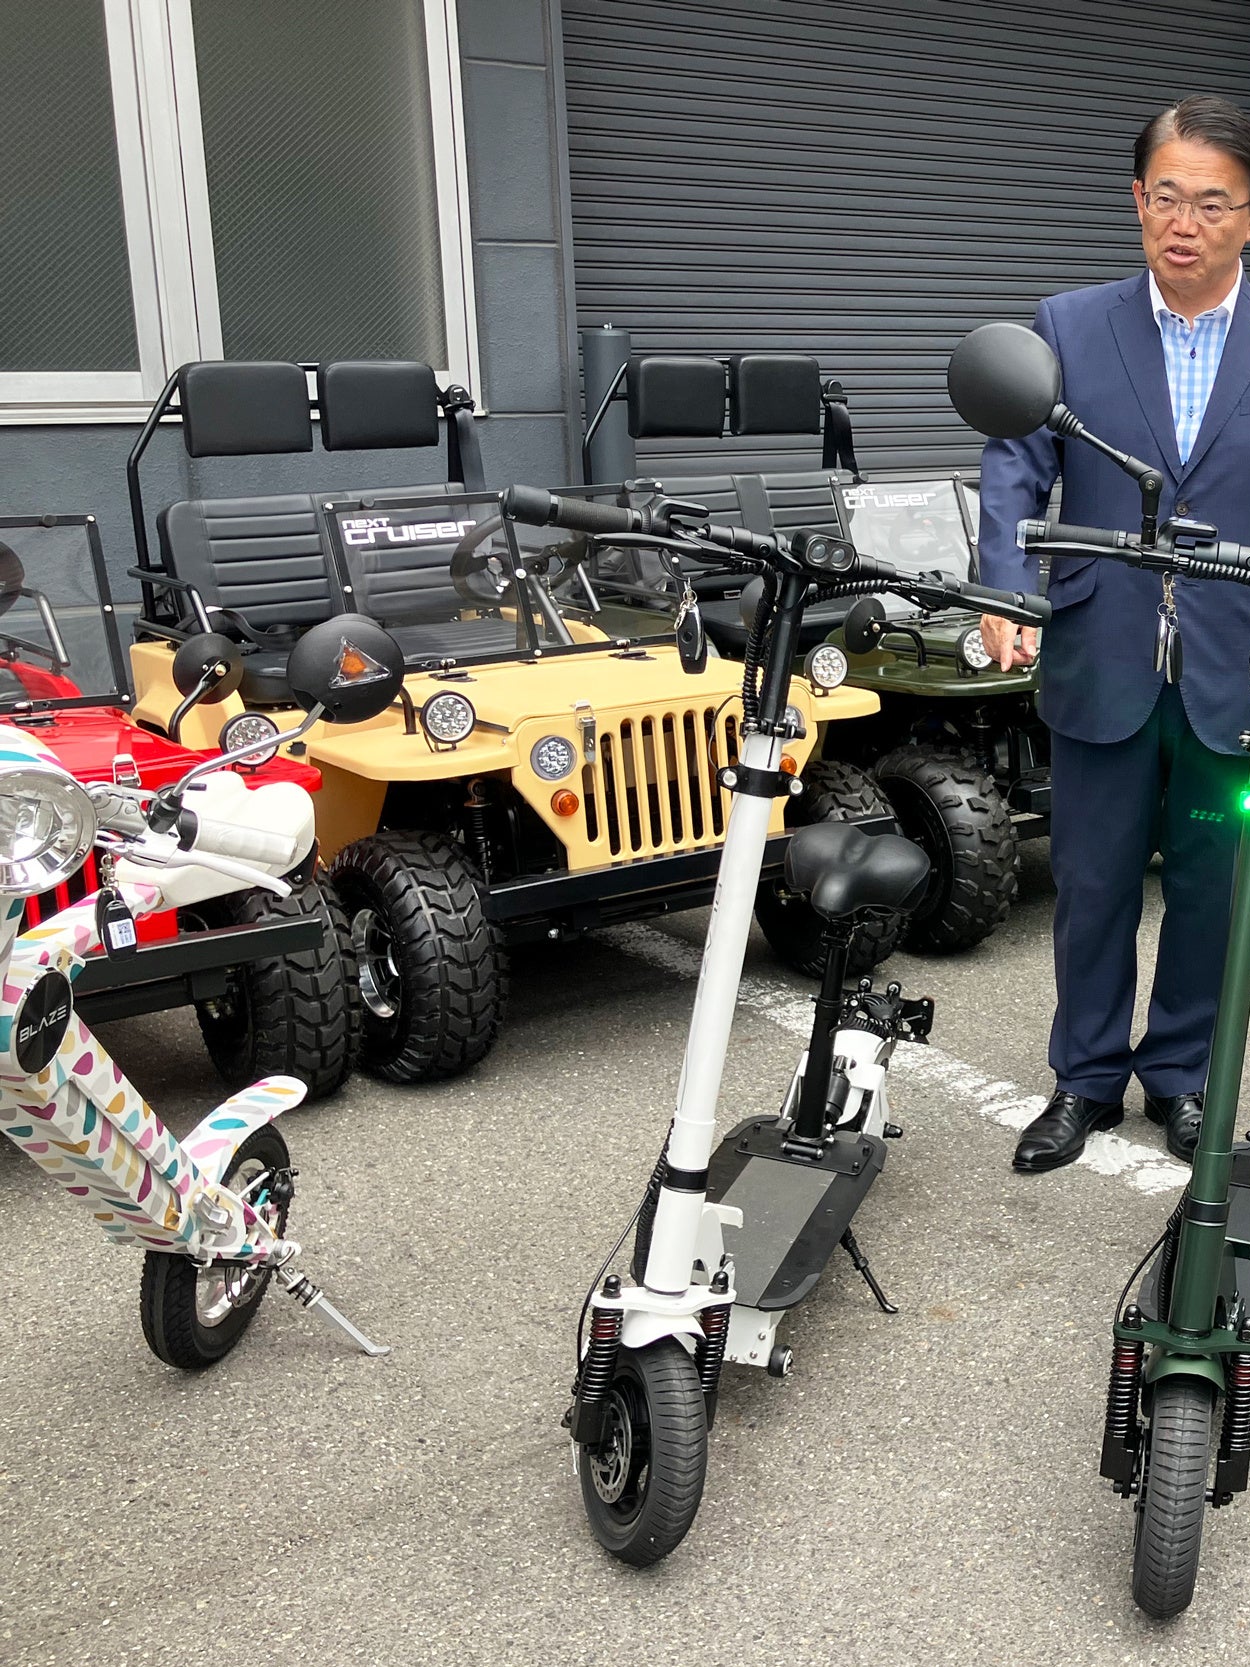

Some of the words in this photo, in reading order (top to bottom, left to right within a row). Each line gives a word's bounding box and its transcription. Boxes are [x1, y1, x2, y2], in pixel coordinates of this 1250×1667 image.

[844, 492, 937, 510] cruiser
[344, 520, 477, 545] cruiser
[19, 1004, 67, 1043] BLAZE
